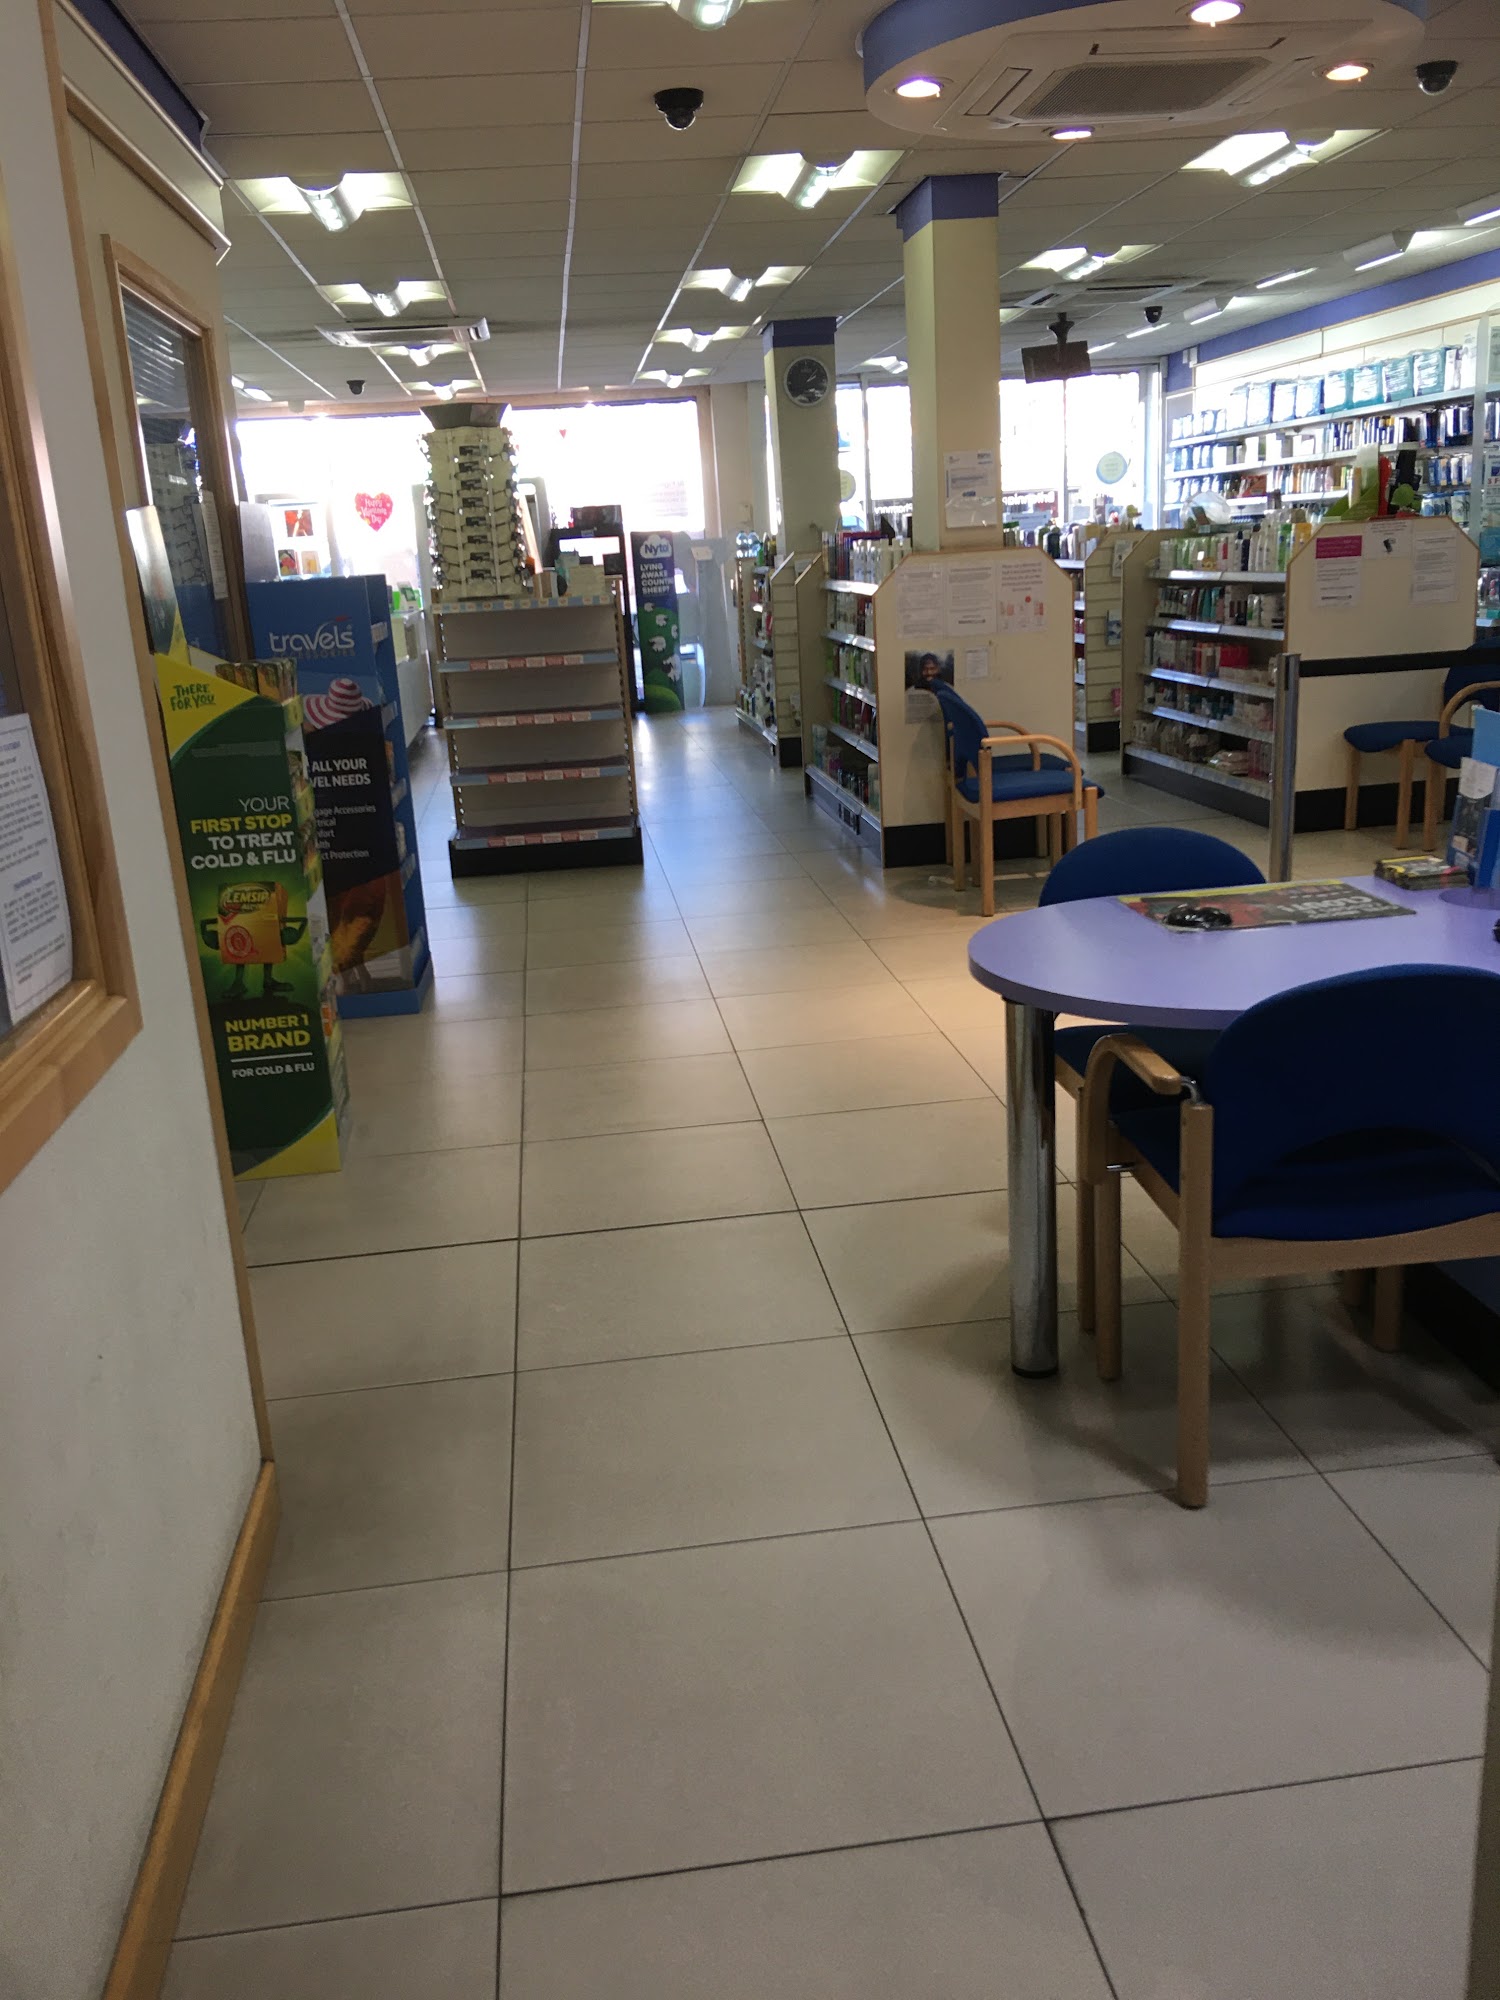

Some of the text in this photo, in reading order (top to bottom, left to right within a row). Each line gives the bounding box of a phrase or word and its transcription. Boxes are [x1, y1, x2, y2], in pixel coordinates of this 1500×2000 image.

[644, 543, 669, 556] Nytol
[640, 562, 664, 571] LYING
[641, 570, 668, 579] AWAKE
[642, 585, 670, 595] SHEEP?
[269, 620, 355, 653] travels
[173, 683, 210, 699] THERE
[170, 693, 215, 711] FOR YOU
[312, 758, 368, 773] ALL YOUR
[310, 773, 372, 788] VEL NEEDS
[239, 796, 290, 812] YOUR
[333, 804, 377, 815] Accessories
[190, 813, 293, 834] FIRST STOP
[317, 817, 337, 828] trical
[208, 831, 295, 850] TO TREAT
[191, 848, 297, 870] COLD & FLU
[329, 849, 370, 860] Protection
[225, 891, 269, 903] LEMSIP
[224, 1013, 310, 1033] NUMBER 1
[227, 1030, 311, 1053] BRAND
[231, 1062, 315, 1079] FOR COLD & FLU
